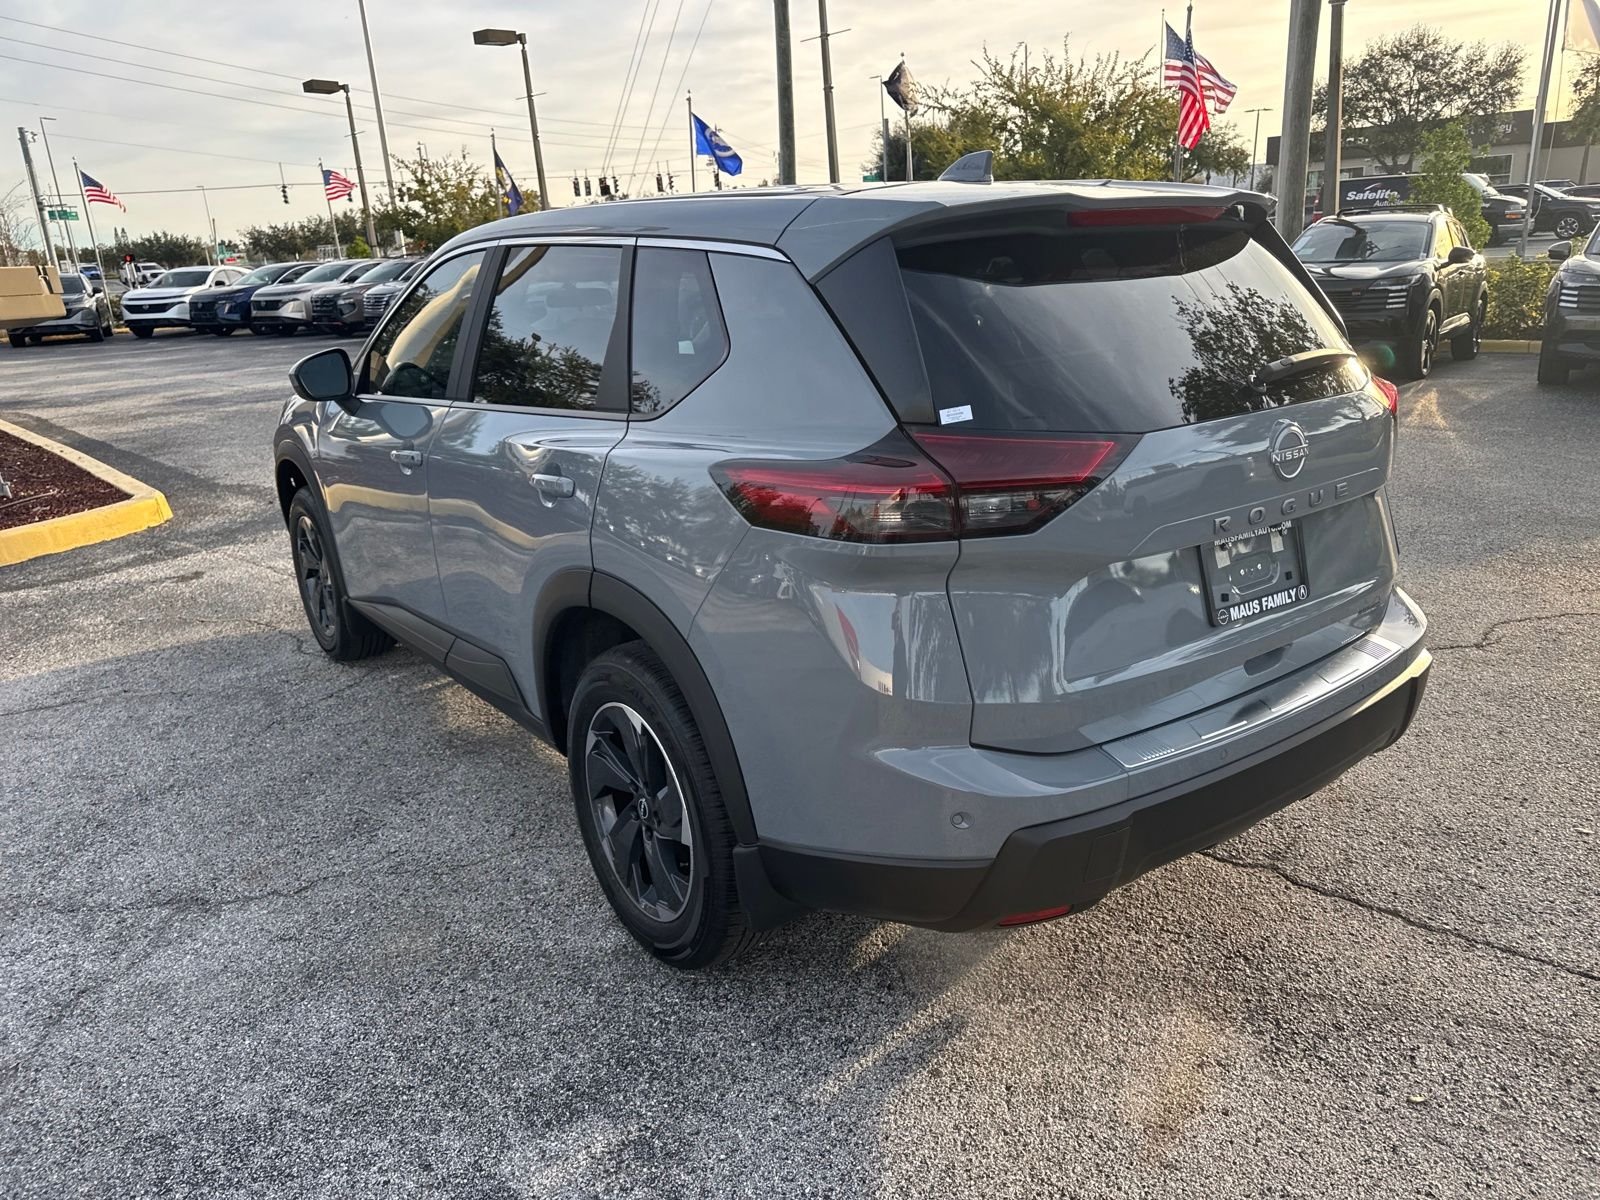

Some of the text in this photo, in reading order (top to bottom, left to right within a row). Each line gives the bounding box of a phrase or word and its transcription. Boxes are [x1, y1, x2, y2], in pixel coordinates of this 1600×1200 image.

[1272, 447, 1309, 463] NISSAN
[1213, 482, 1349, 534] ROGUE
[1229, 588, 1297, 621] MAUS FAMILY
